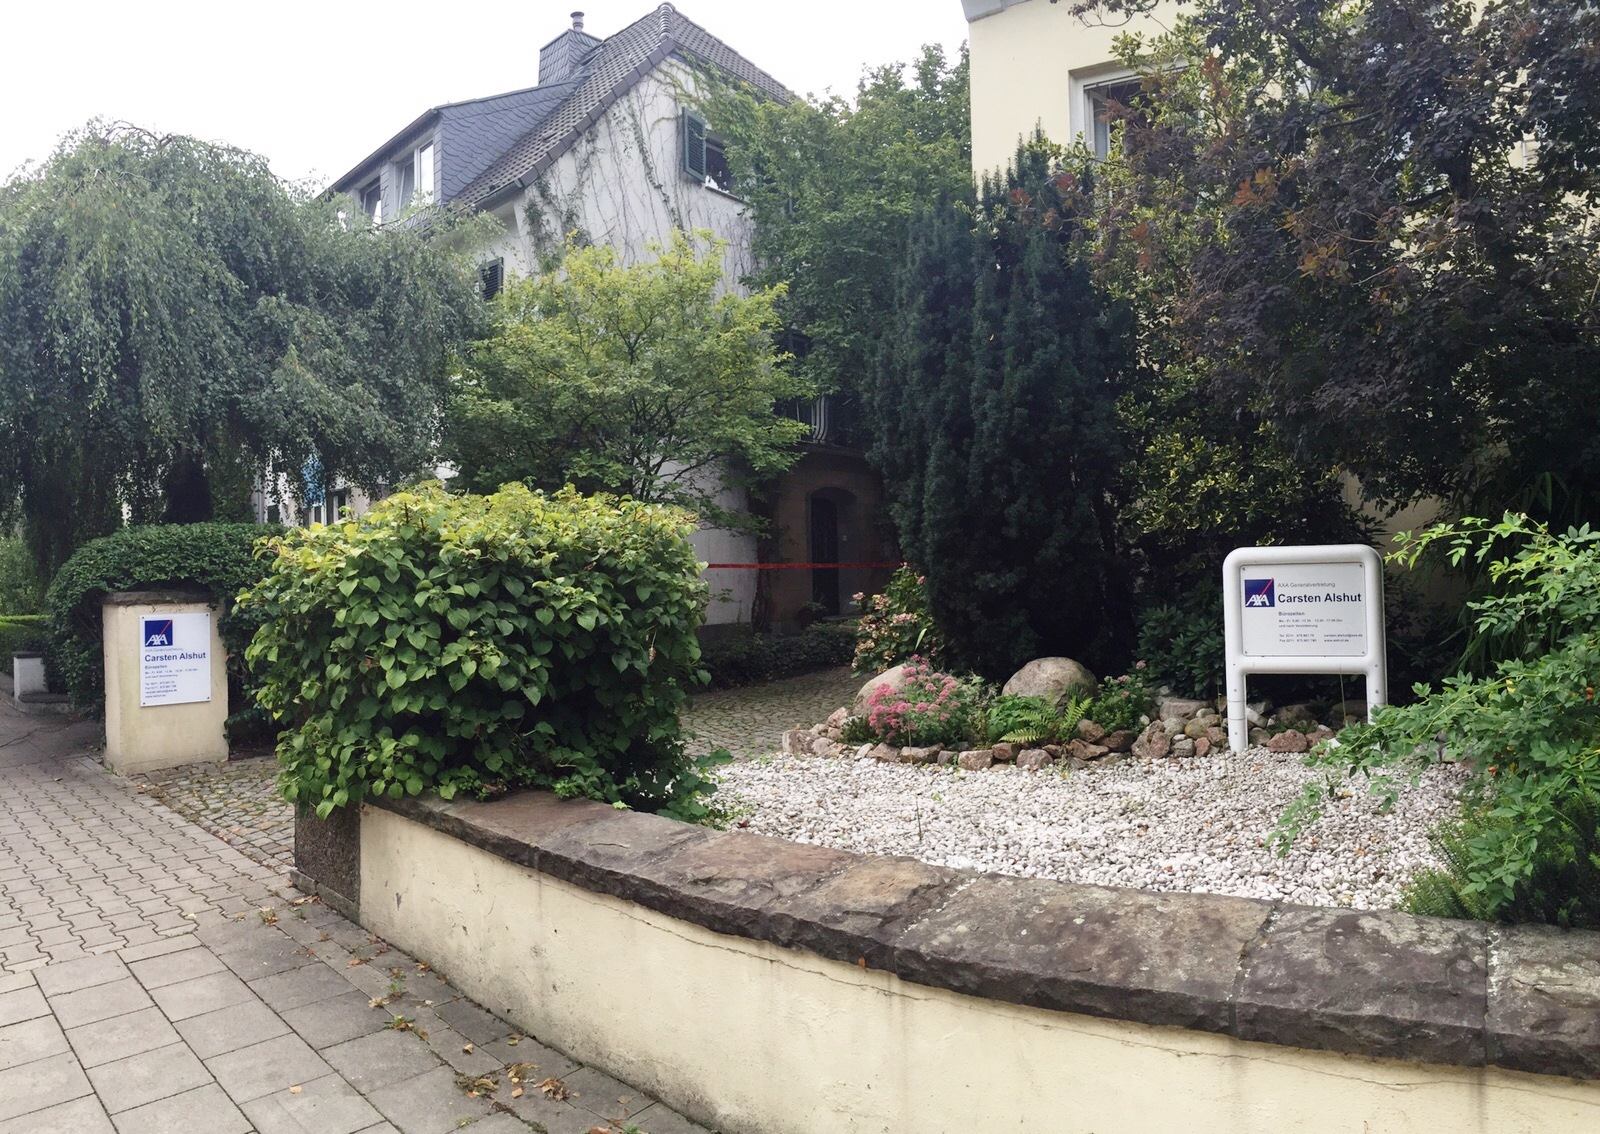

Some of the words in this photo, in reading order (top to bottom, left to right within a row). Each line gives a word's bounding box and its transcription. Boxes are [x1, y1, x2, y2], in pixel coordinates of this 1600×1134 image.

[1245, 594, 1270, 607] AXA
[1277, 593, 1321, 603] Carsten
[1324, 592, 1362, 602] Alshut
[145, 634, 168, 646] AXA
[144, 654, 177, 662] Carsten
[179, 652, 206, 660] Alshut
